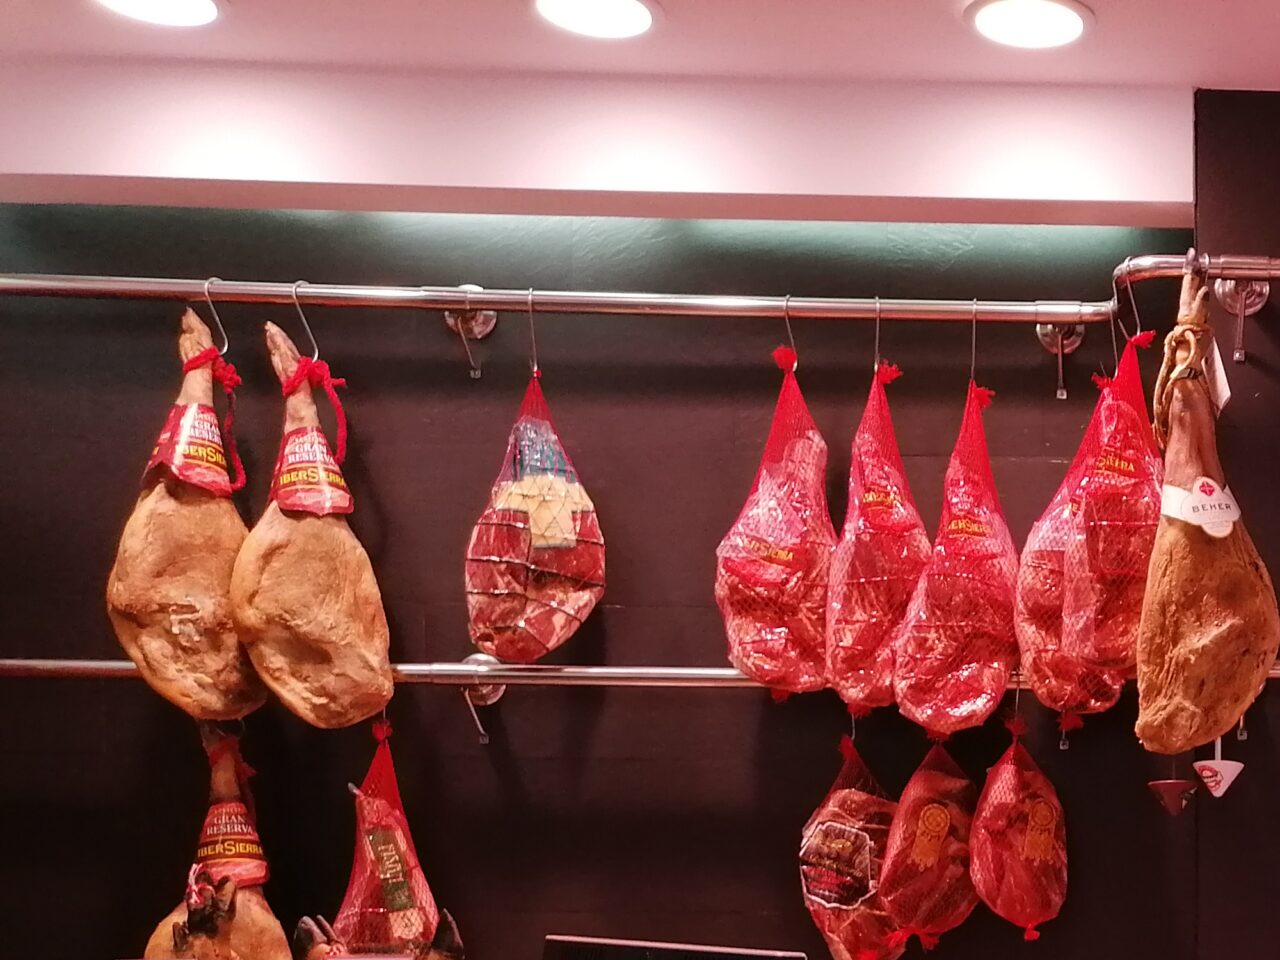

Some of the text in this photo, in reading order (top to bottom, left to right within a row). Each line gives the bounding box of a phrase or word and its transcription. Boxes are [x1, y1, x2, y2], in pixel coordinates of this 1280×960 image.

[295, 442, 327, 453] GRAN
[287, 452, 336, 464] RESERVA
[1192, 503, 1232, 513] BEHER
[214, 814, 246, 825] GRAN
[206, 823, 254, 836] RESERVA
